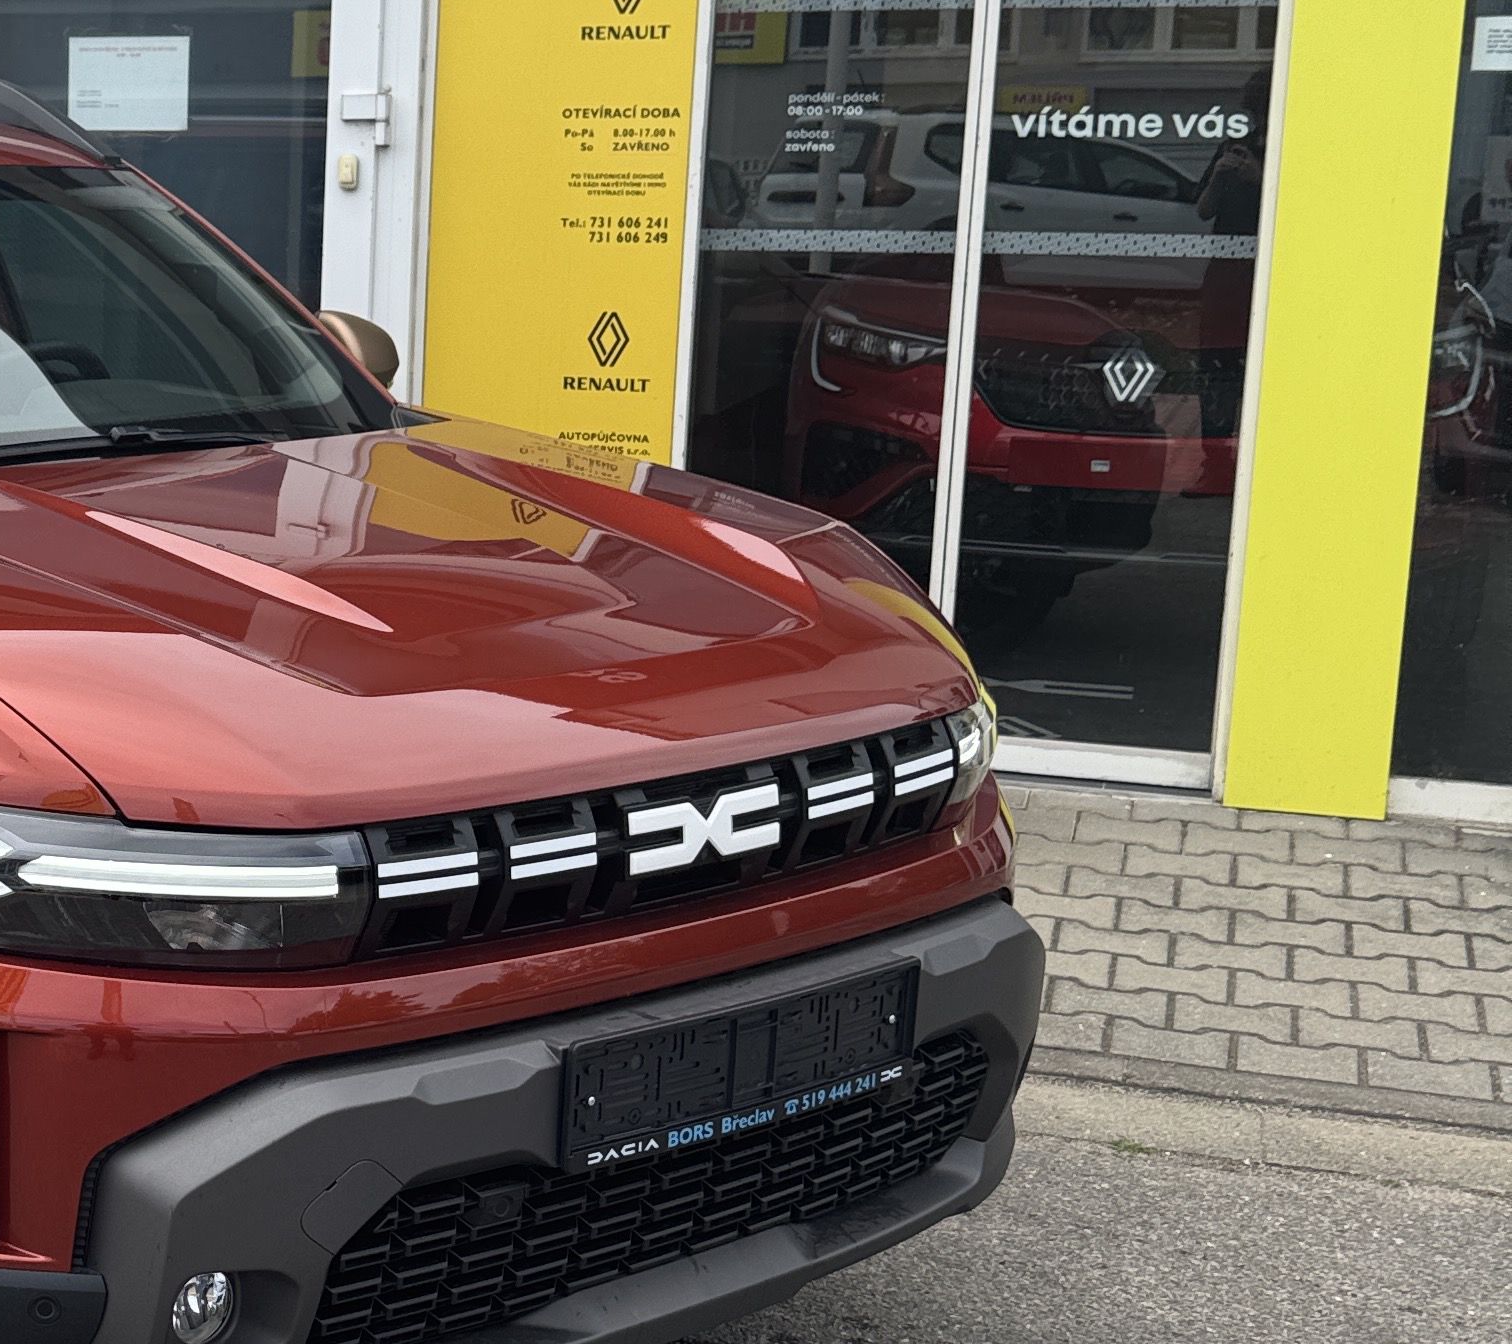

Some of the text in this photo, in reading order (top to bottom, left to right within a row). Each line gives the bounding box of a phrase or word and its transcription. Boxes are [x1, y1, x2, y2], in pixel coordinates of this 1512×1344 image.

[581, 25, 671, 40] RENAULT
[562, 104, 681, 118] OTEVÍRACÍ DOBA
[1011, 106, 1250, 139] vítáme vás
[580, 140, 670, 152] So ZAVŘENO
[784, 141, 836, 152] zavřeno
[590, 216, 612, 228] 731
[618, 216, 641, 228] 606
[646, 217, 668, 228] 241
[588, 232, 668, 243] 731 606 249
[563, 376, 651, 392] RENAULT
[588, 1073, 876, 1165] DACIA BORS Břeclav 519 444 241
